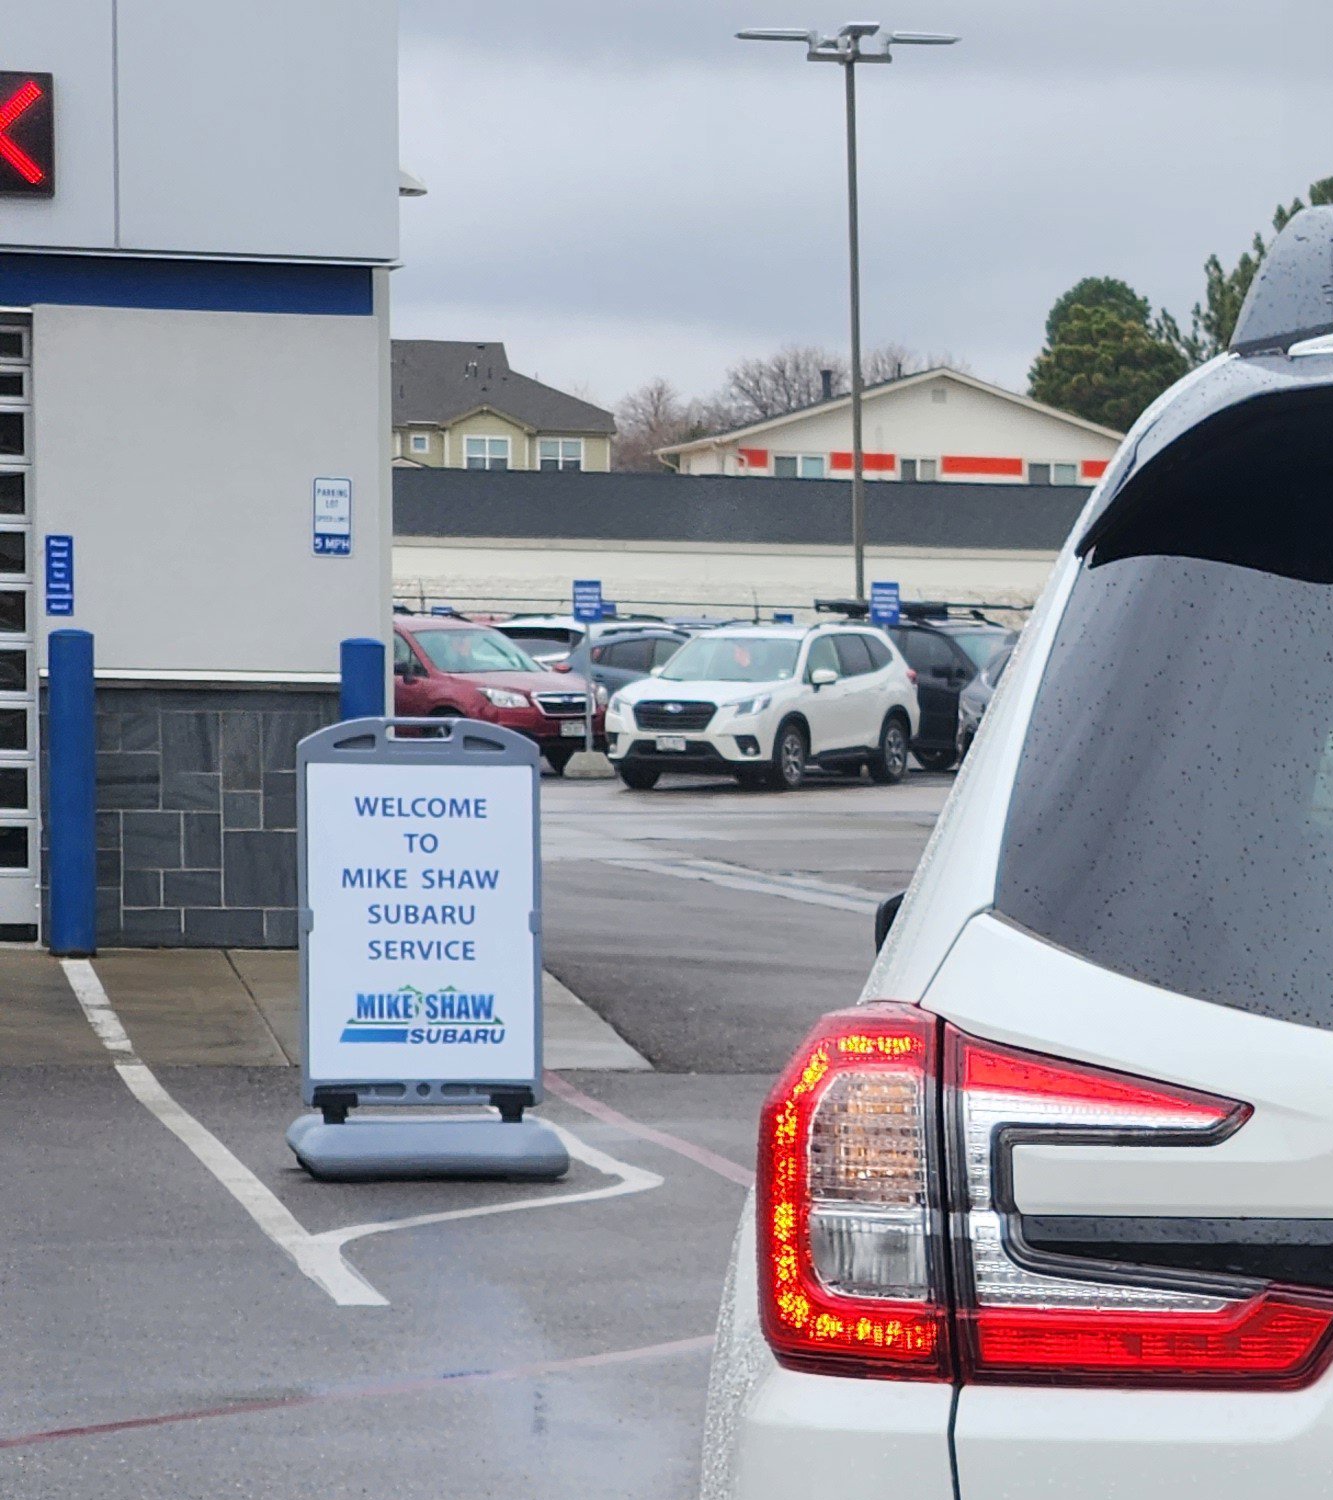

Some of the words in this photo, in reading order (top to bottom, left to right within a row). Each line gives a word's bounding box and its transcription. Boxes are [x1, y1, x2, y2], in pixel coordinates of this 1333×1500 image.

[315, 537, 323, 549] 5
[325, 538, 350, 550] MPH
[355, 796, 488, 819] WELCOME
[404, 833, 440, 854] TO
[342, 868, 408, 889] MIKE
[422, 868, 500, 890] SHAW
[368, 904, 476, 925] SUBARU
[368, 940, 476, 961] SERVICE
[356, 993, 413, 1020] MIKE
[425, 993, 495, 1020] SHAW
[410, 1028, 506, 1045] SUBARU
